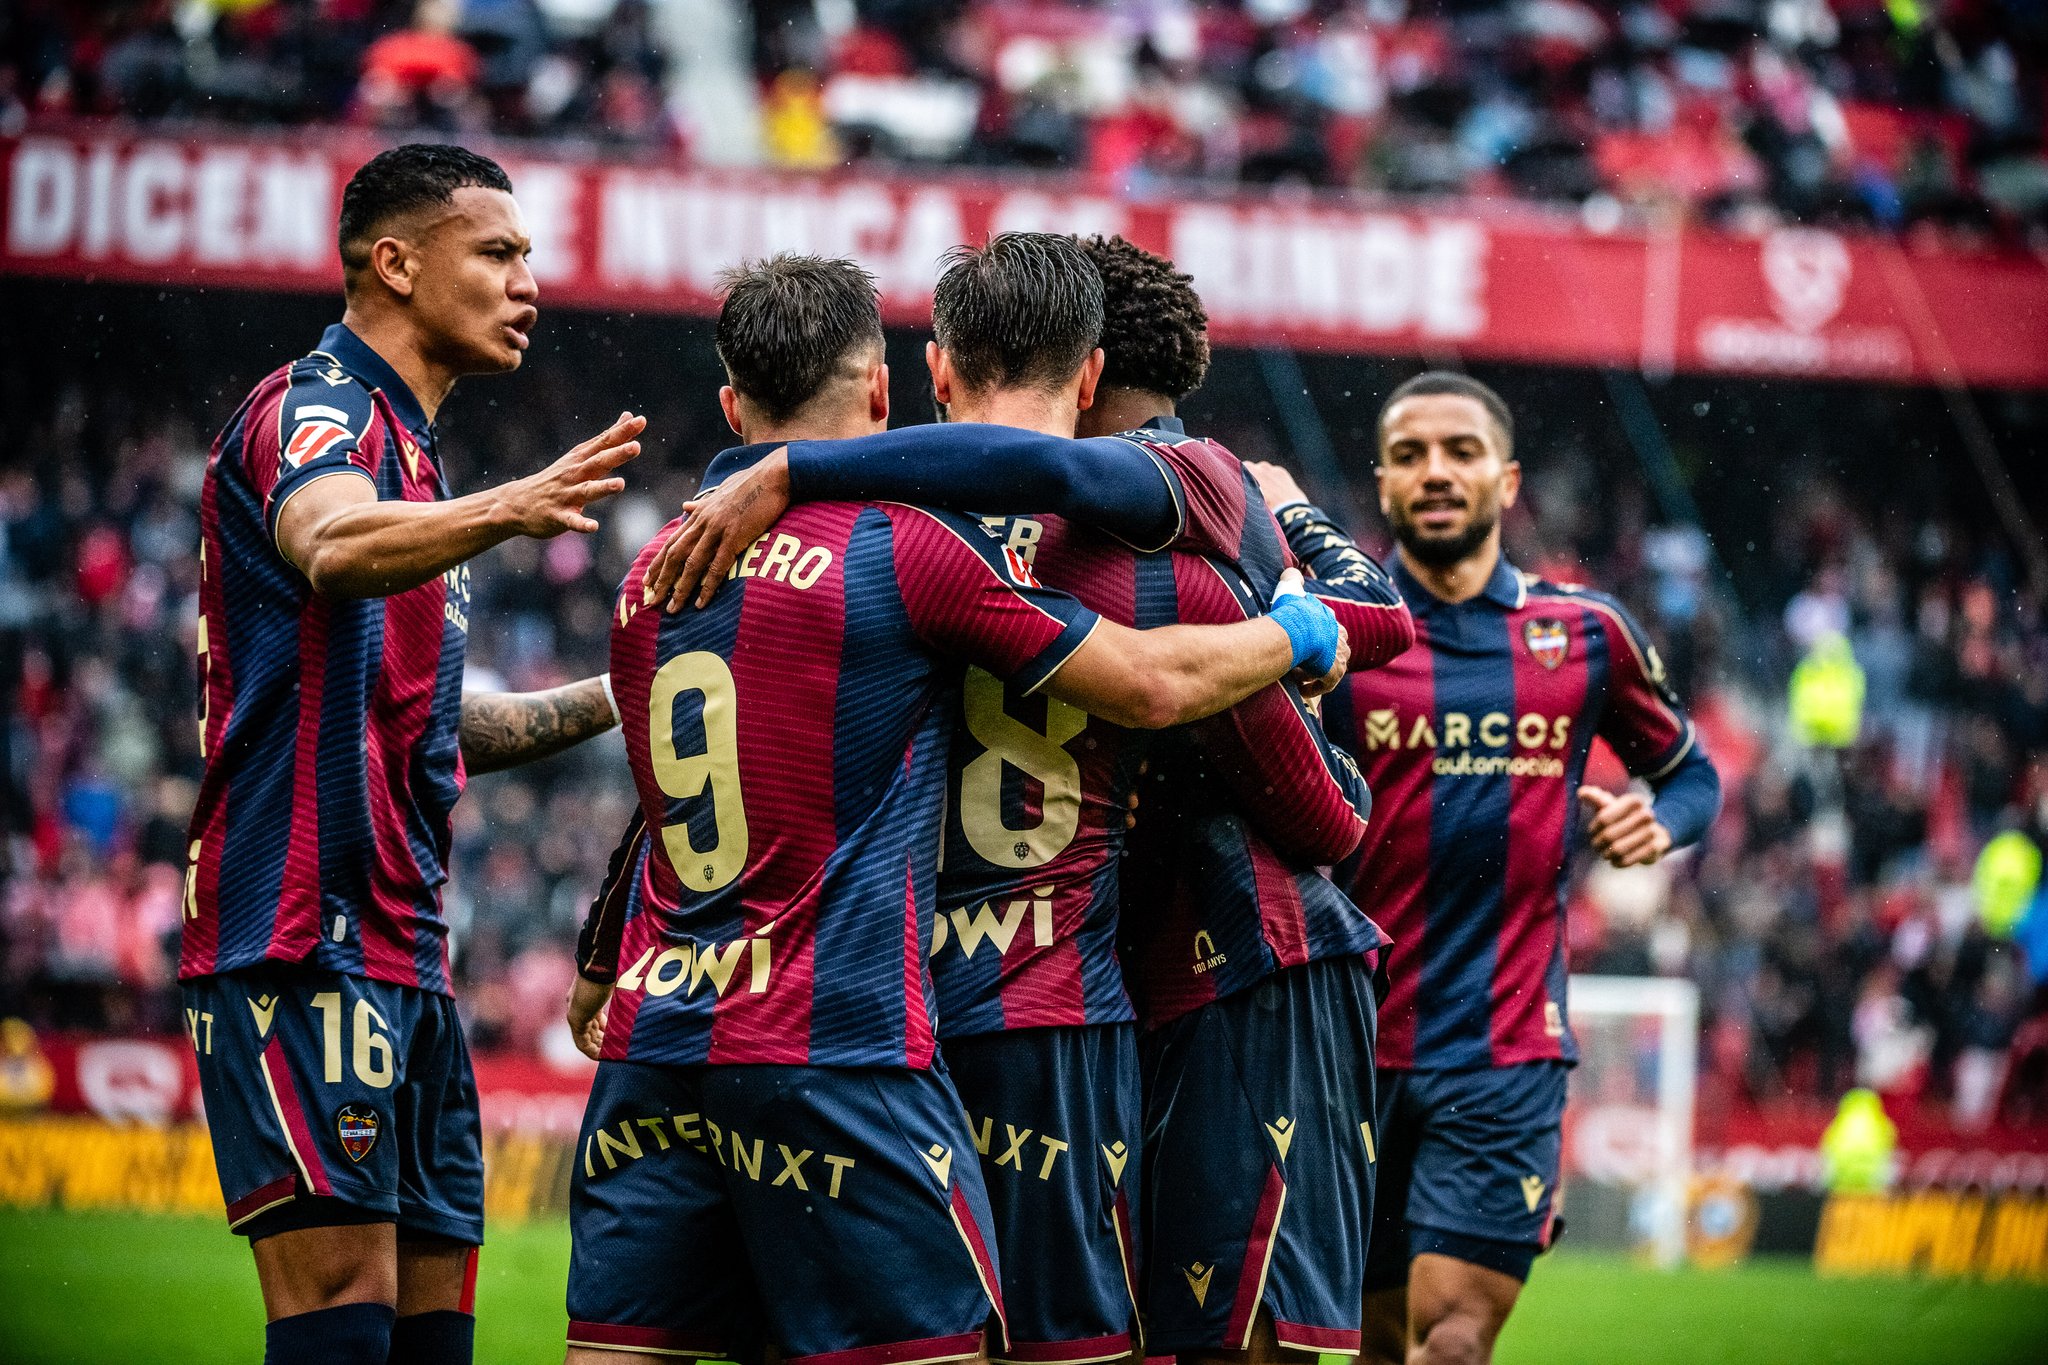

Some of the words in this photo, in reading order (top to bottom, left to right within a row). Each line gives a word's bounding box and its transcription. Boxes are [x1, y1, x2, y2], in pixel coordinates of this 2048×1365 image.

[8, 138, 333, 270] DICEN
[649, 650, 749, 891] 9
[936, 664, 1088, 868] 8
[1365, 709, 1572, 751] MARCOS
[1192, 962, 1207, 975] 100
[1207, 953, 1227, 970] ANYS
[310, 992, 394, 1088] 16
[584, 1112, 856, 1199] INTERNXT
